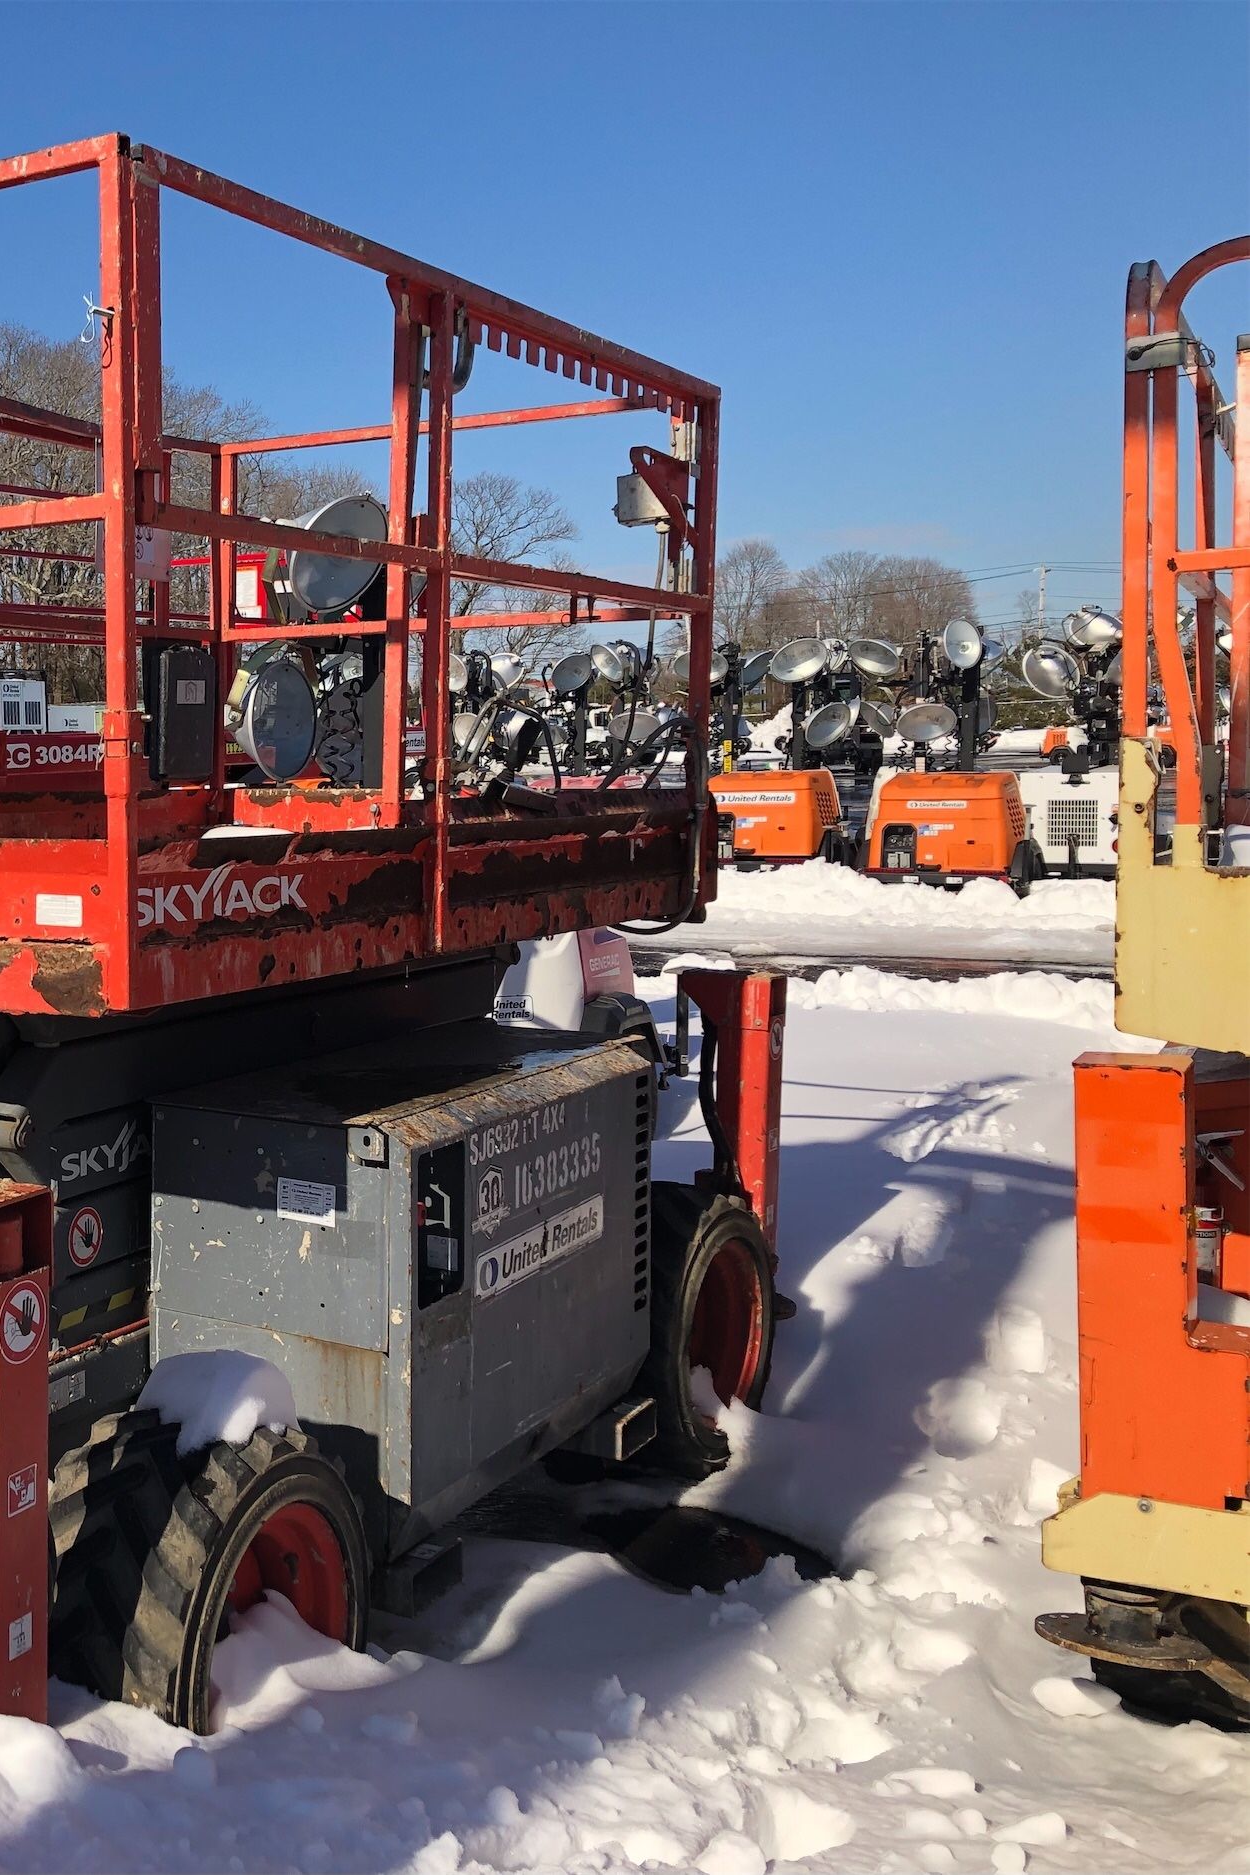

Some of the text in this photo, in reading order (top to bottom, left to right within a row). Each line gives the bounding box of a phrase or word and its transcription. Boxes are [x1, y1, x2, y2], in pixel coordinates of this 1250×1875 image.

[405, 736, 425, 748] entals
[35, 744, 101, 765] 3084R
[727, 793, 792, 803] United Rentals
[137, 859, 307, 927] SKYJACK
[492, 1010, 531, 1019] Rentals
[60, 1119, 150, 1182] SKYJA
[501, 1241, 548, 1280] United
[551, 1206, 598, 1252] Rentals
